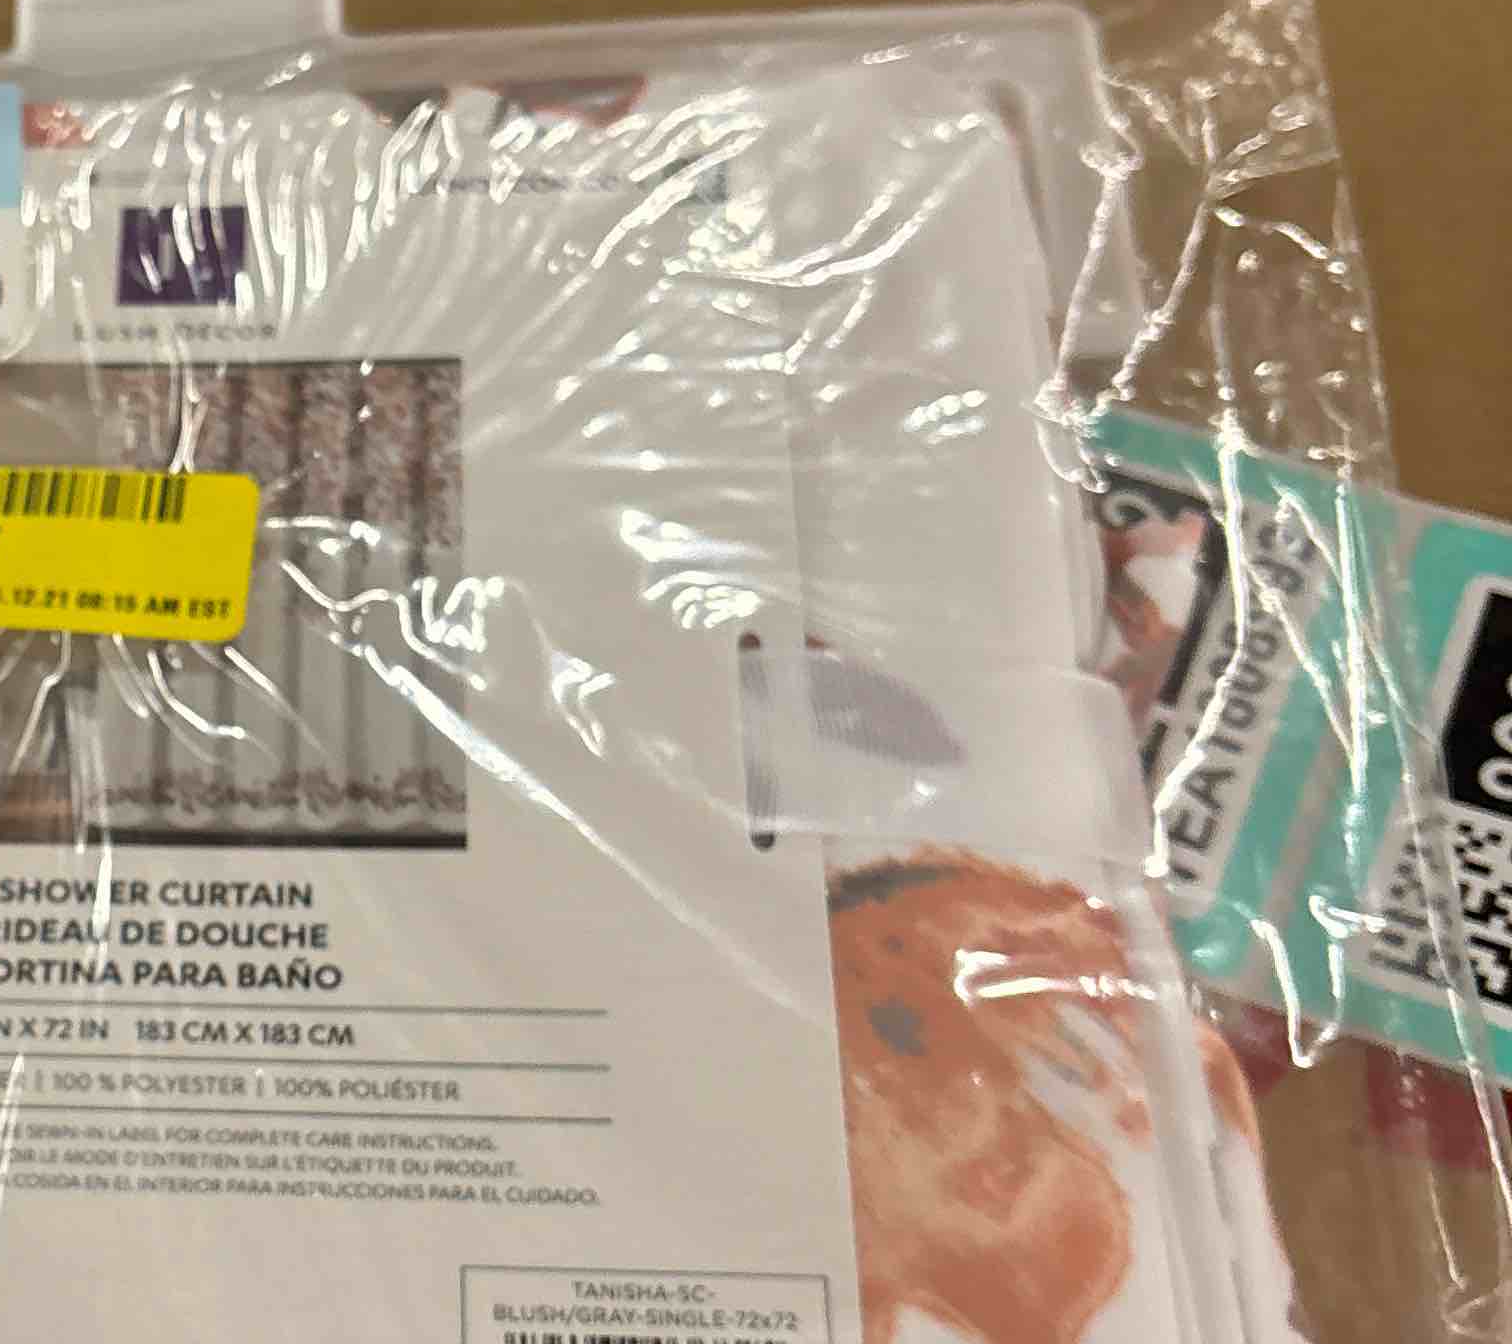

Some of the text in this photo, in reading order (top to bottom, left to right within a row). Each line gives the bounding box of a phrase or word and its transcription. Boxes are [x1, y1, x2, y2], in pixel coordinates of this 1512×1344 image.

[144, 595, 180, 615] AM
[188, 598, 232, 619] EST
[159, 880, 313, 908] CURTAIN
[120, 920, 165, 946] DE
[176, 921, 329, 948] DOUCHE
[133, 960, 228, 987] PARA
[237, 956, 343, 990] BAÑO
[18, 1016, 37, 1038] X
[43, 1017, 73, 1040] 72
[79, 1018, 110, 1040] IN
[136, 1019, 176, 1041] 183
[182, 1020, 228, 1043] CM
[234, 1022, 254, 1043] X
[260, 1023, 301, 1045] 183
[308, 1024, 355, 1046] CM
[123, 1072, 246, 1095] POLYESTER
[275, 1076, 333, 1098] 100%
[572, 1280, 717, 1304] TANISHA-SC-
